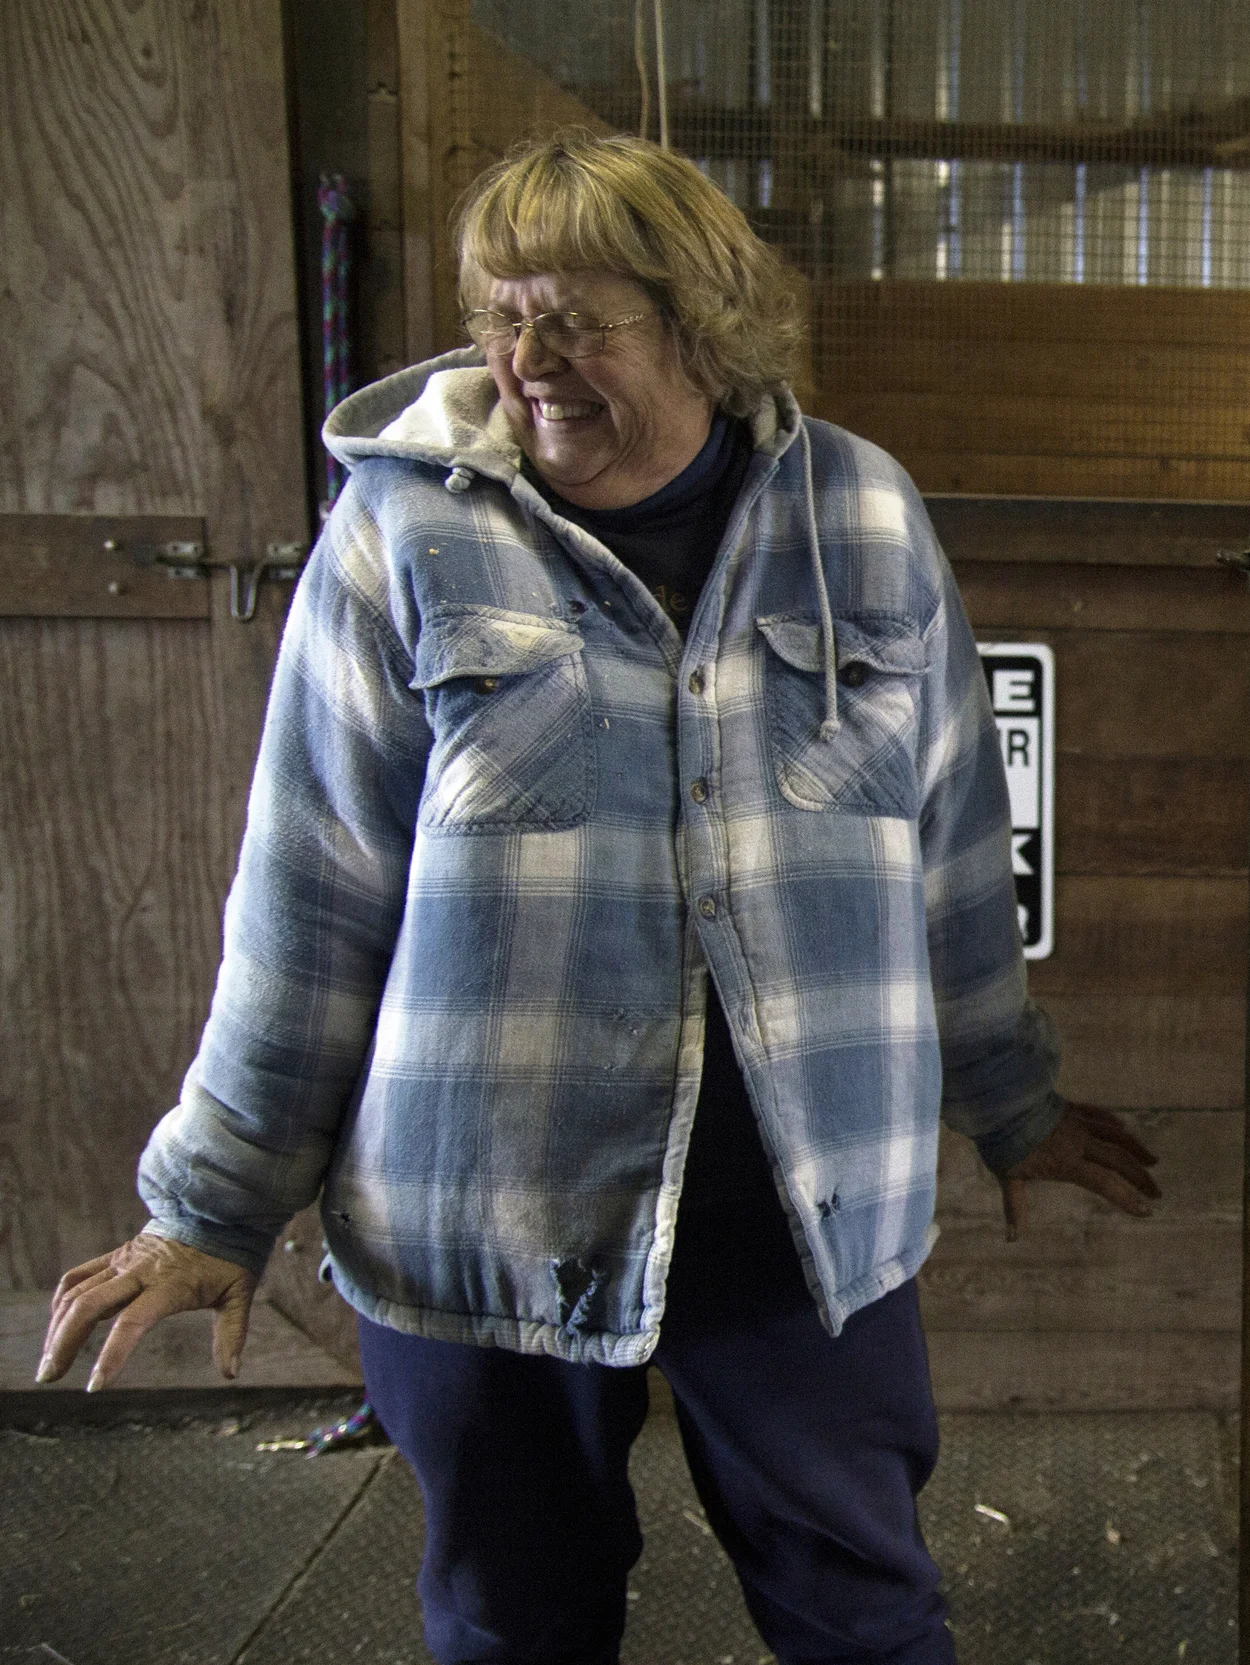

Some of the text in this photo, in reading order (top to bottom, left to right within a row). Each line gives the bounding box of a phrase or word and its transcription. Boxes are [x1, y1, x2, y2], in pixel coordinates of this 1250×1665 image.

[993, 670, 1035, 712] E
[1008, 730, 1029, 767] R
[1011, 834, 1034, 874] K
